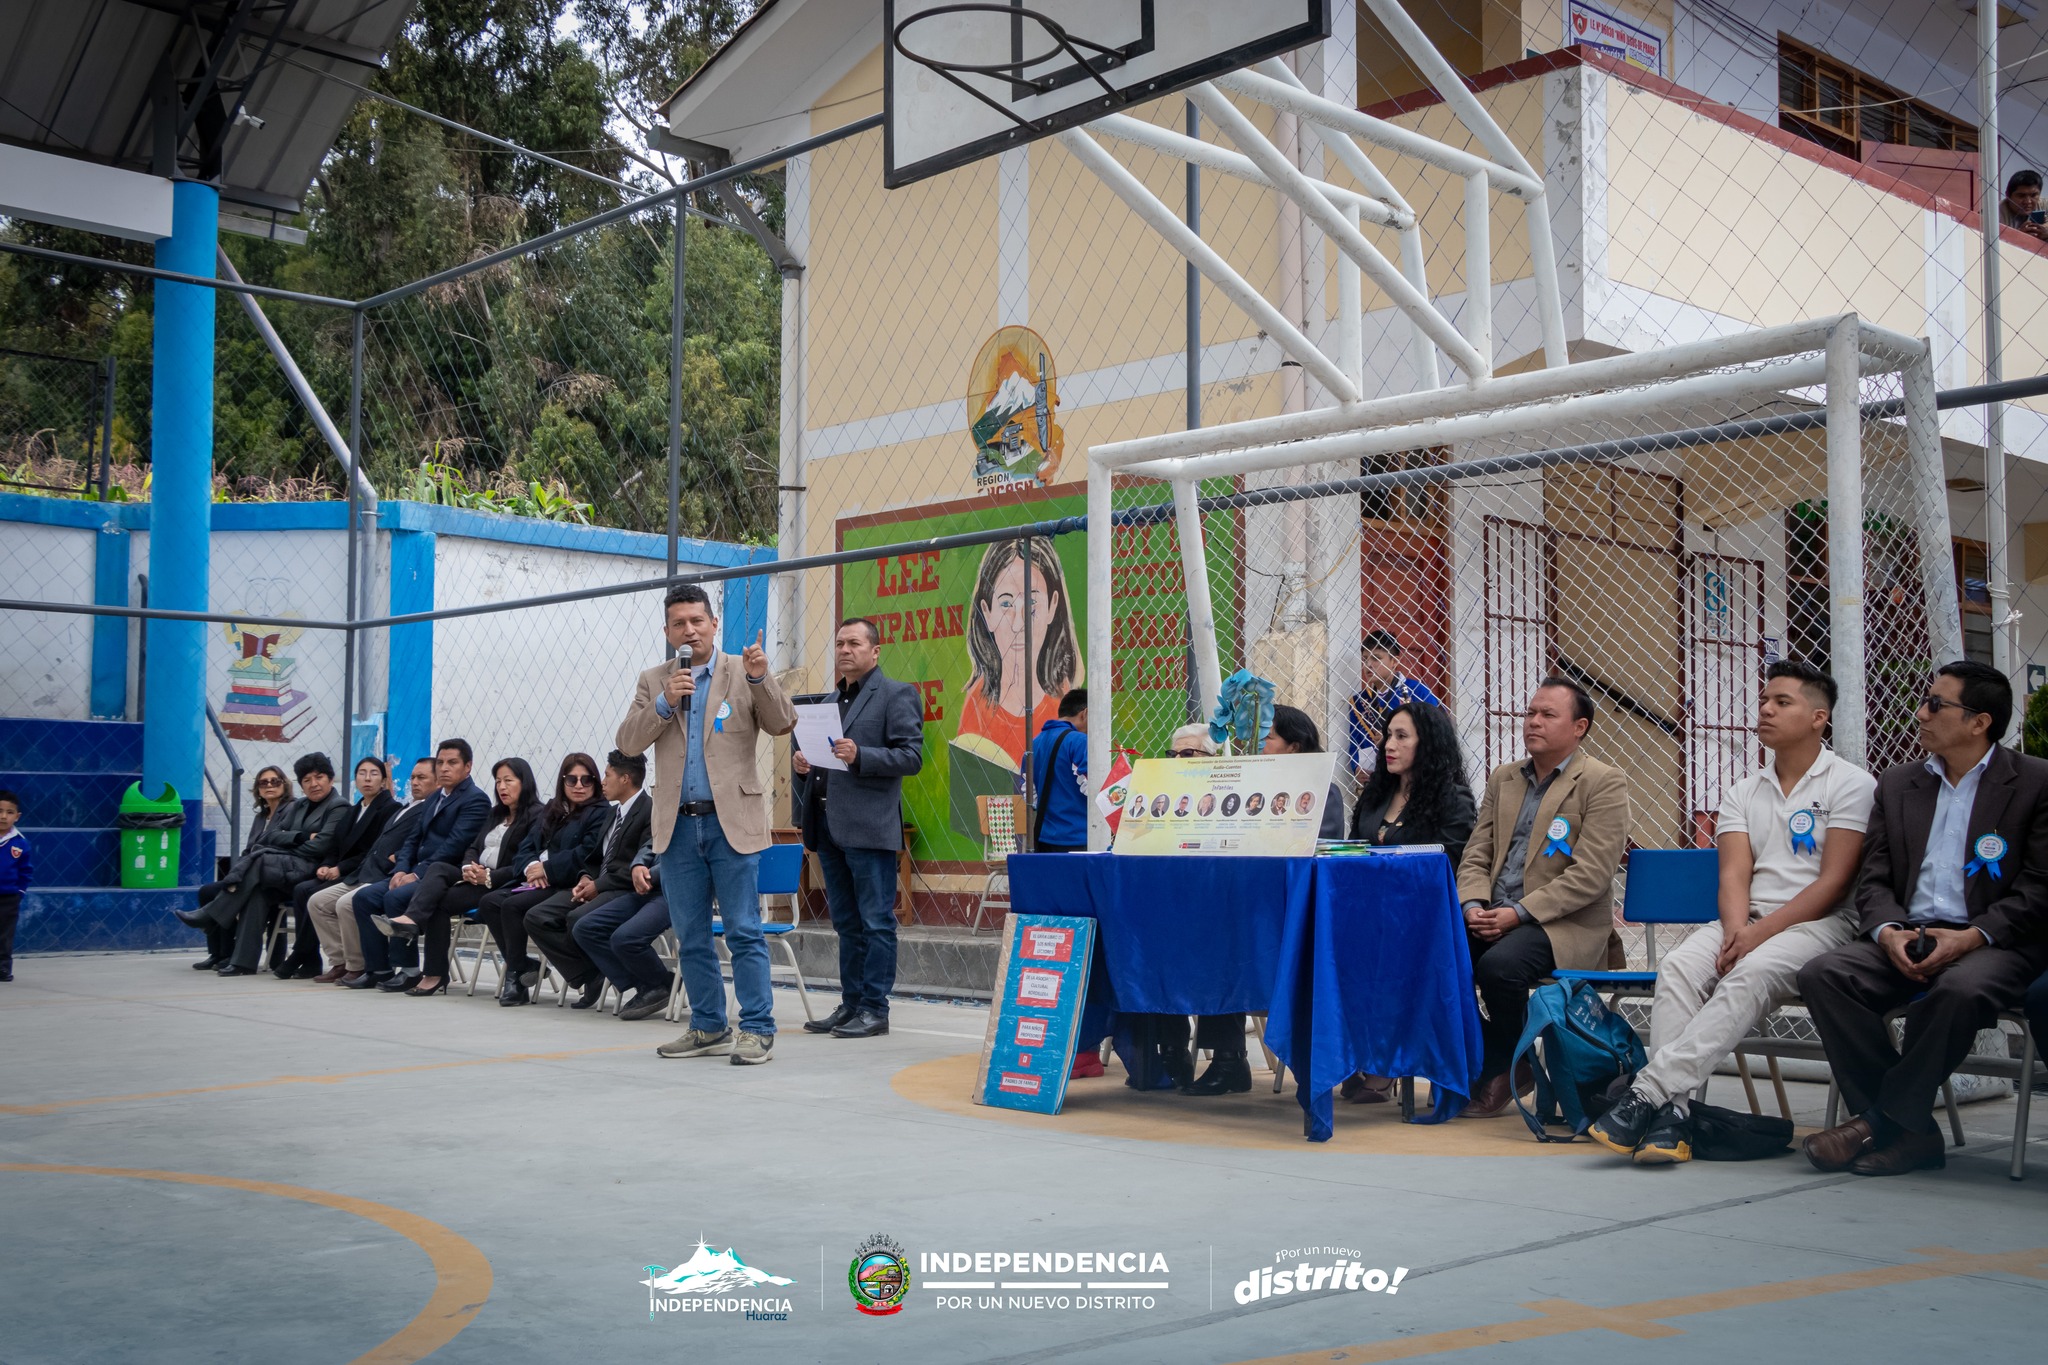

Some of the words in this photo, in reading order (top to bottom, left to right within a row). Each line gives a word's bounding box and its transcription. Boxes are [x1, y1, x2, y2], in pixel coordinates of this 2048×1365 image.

[977, 472, 1010, 487] REGION
[877, 550, 940, 597] LEE
[1112, 561, 1187, 599] ECTO
[1112, 610, 1188, 651] AÑAN
[1112, 659, 1125, 692] N
[914, 680, 944, 721] E
